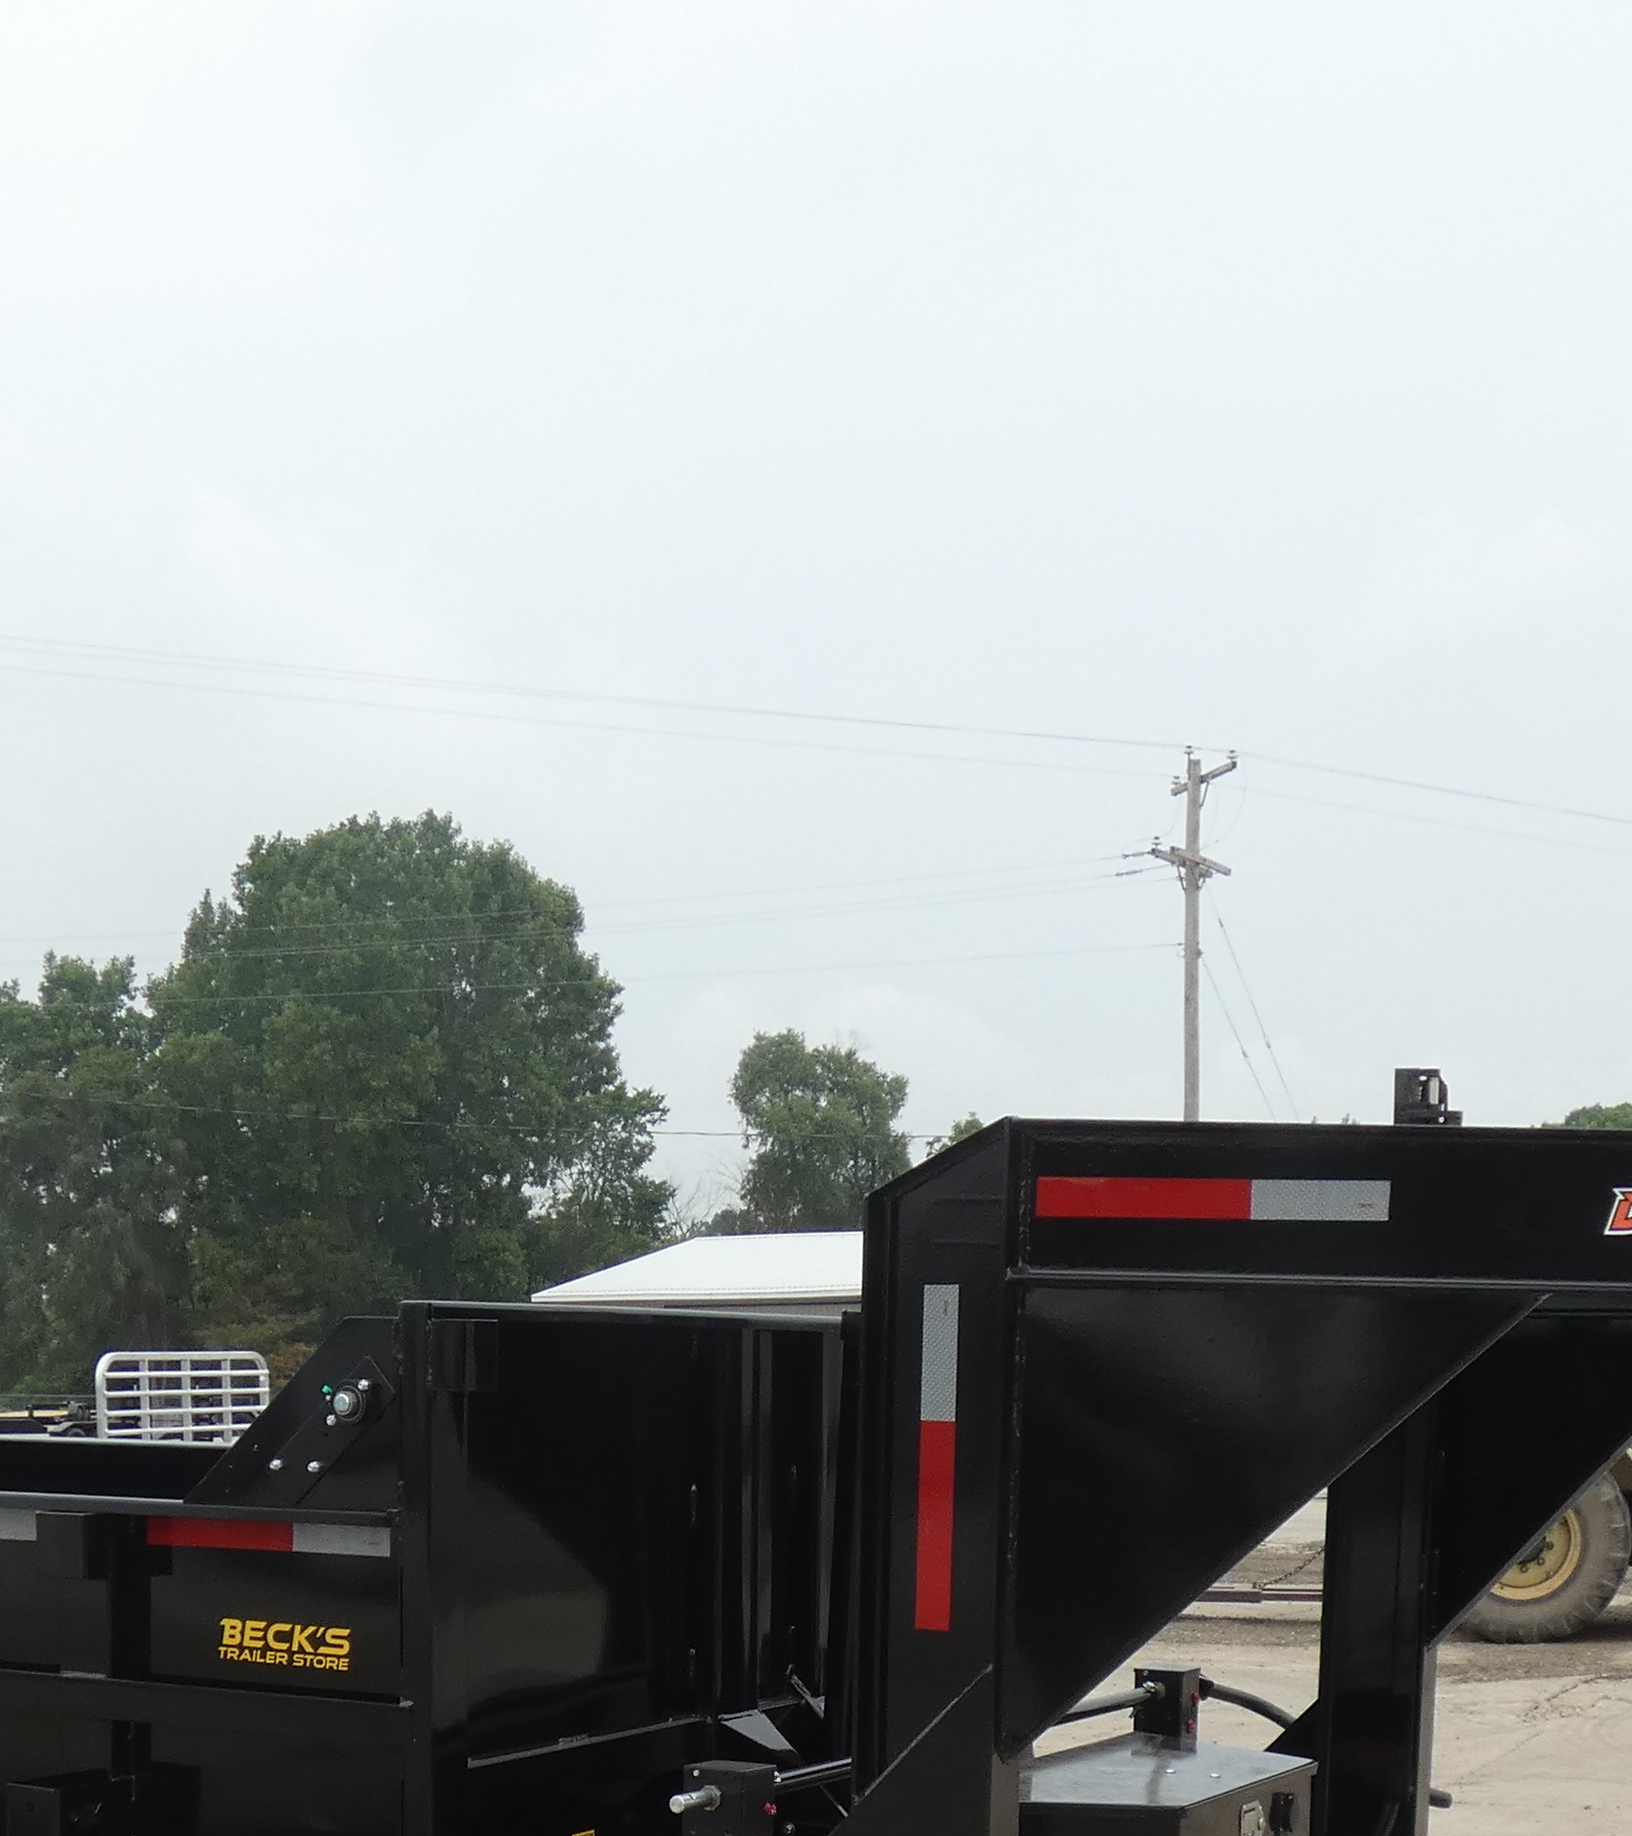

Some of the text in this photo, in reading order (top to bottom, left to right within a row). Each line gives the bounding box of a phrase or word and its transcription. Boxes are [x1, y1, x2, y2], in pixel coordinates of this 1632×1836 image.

[219, 1617, 351, 1656] BECK'S
[217, 1646, 350, 1671] TRAILER STORE
